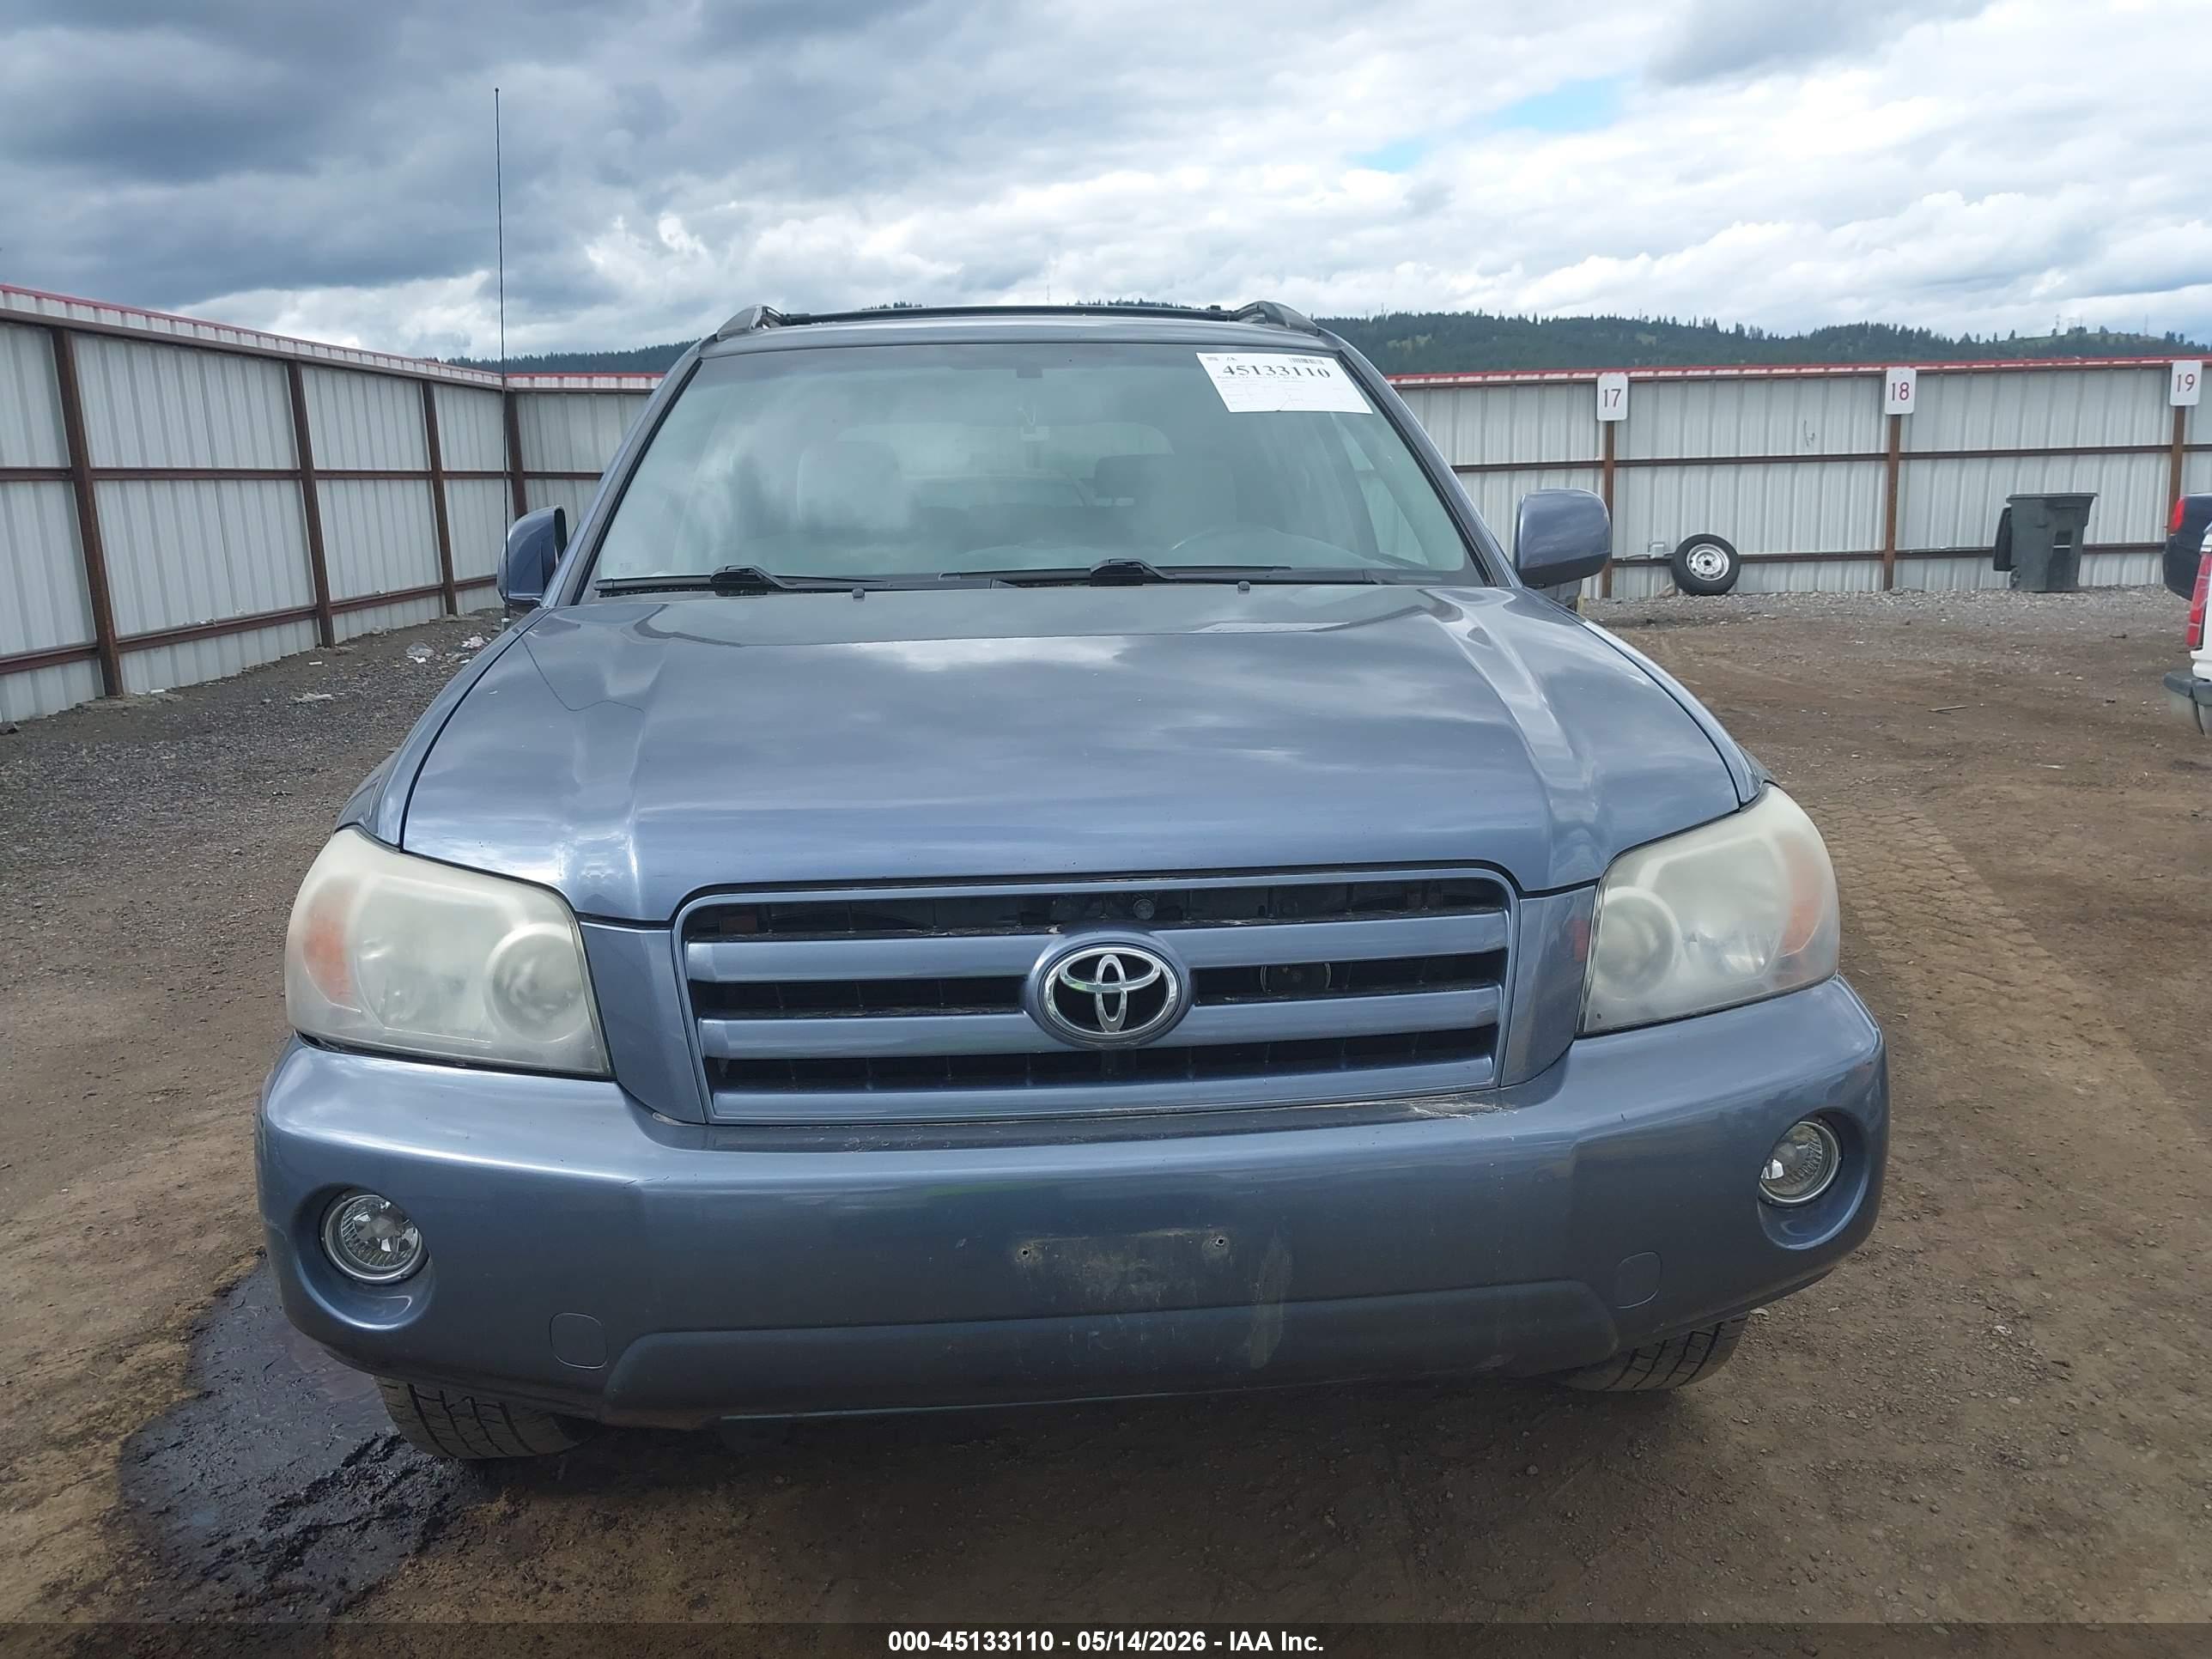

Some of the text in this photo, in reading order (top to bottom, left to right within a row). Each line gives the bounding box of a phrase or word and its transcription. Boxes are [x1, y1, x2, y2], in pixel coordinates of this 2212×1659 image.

[1223, 365, 1331, 379] 45133110
[1892, 381, 1910, 401] 18
[2177, 374, 2196, 392] 19
[1604, 388, 1621, 408] 17
